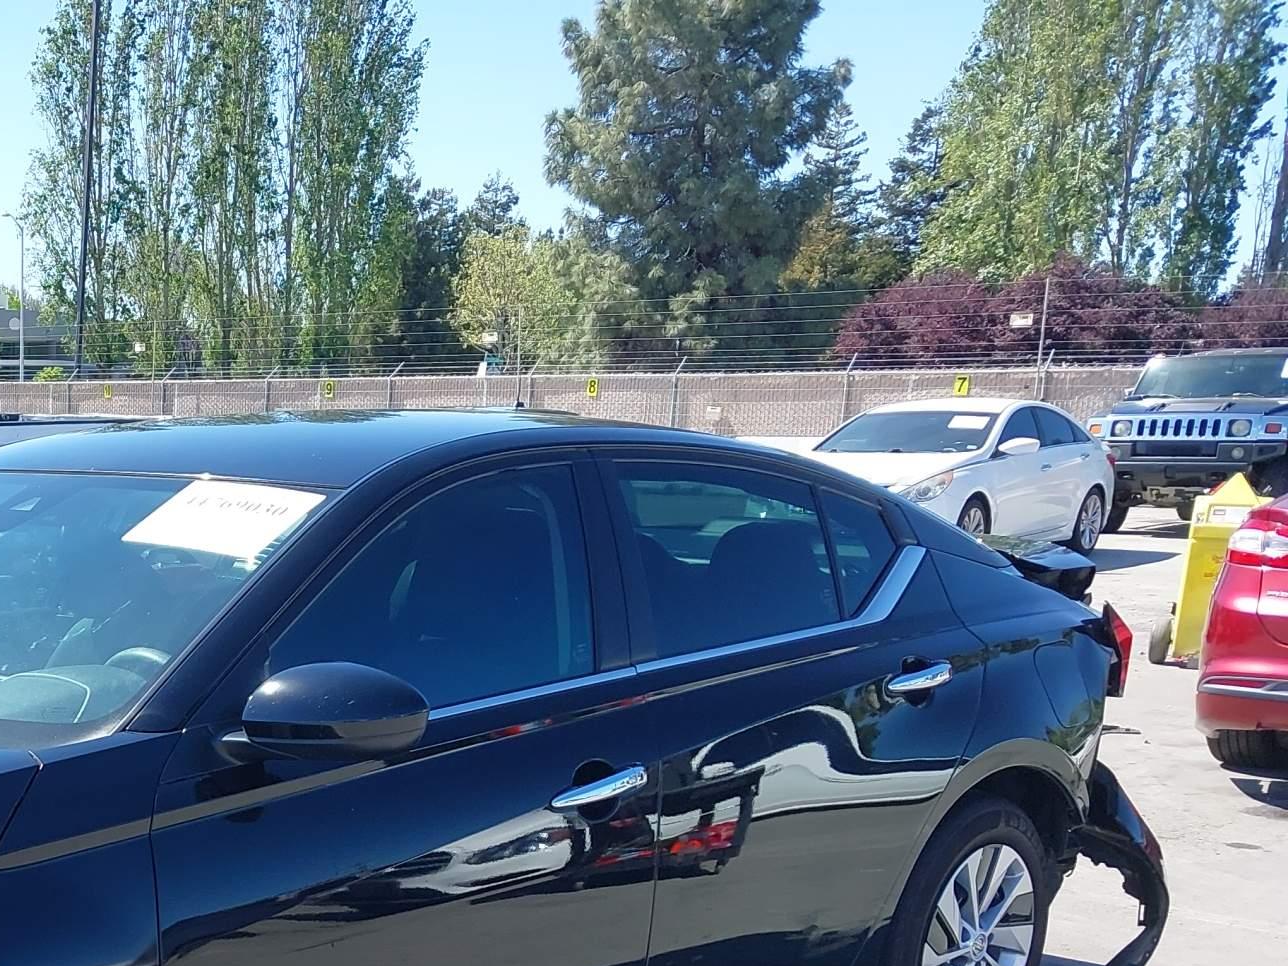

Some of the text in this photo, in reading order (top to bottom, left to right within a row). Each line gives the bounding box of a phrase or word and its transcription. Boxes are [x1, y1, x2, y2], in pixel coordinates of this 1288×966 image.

[326, 382, 332, 396] 9
[588, 379, 597, 394] 8
[956, 376, 968, 393] 7
